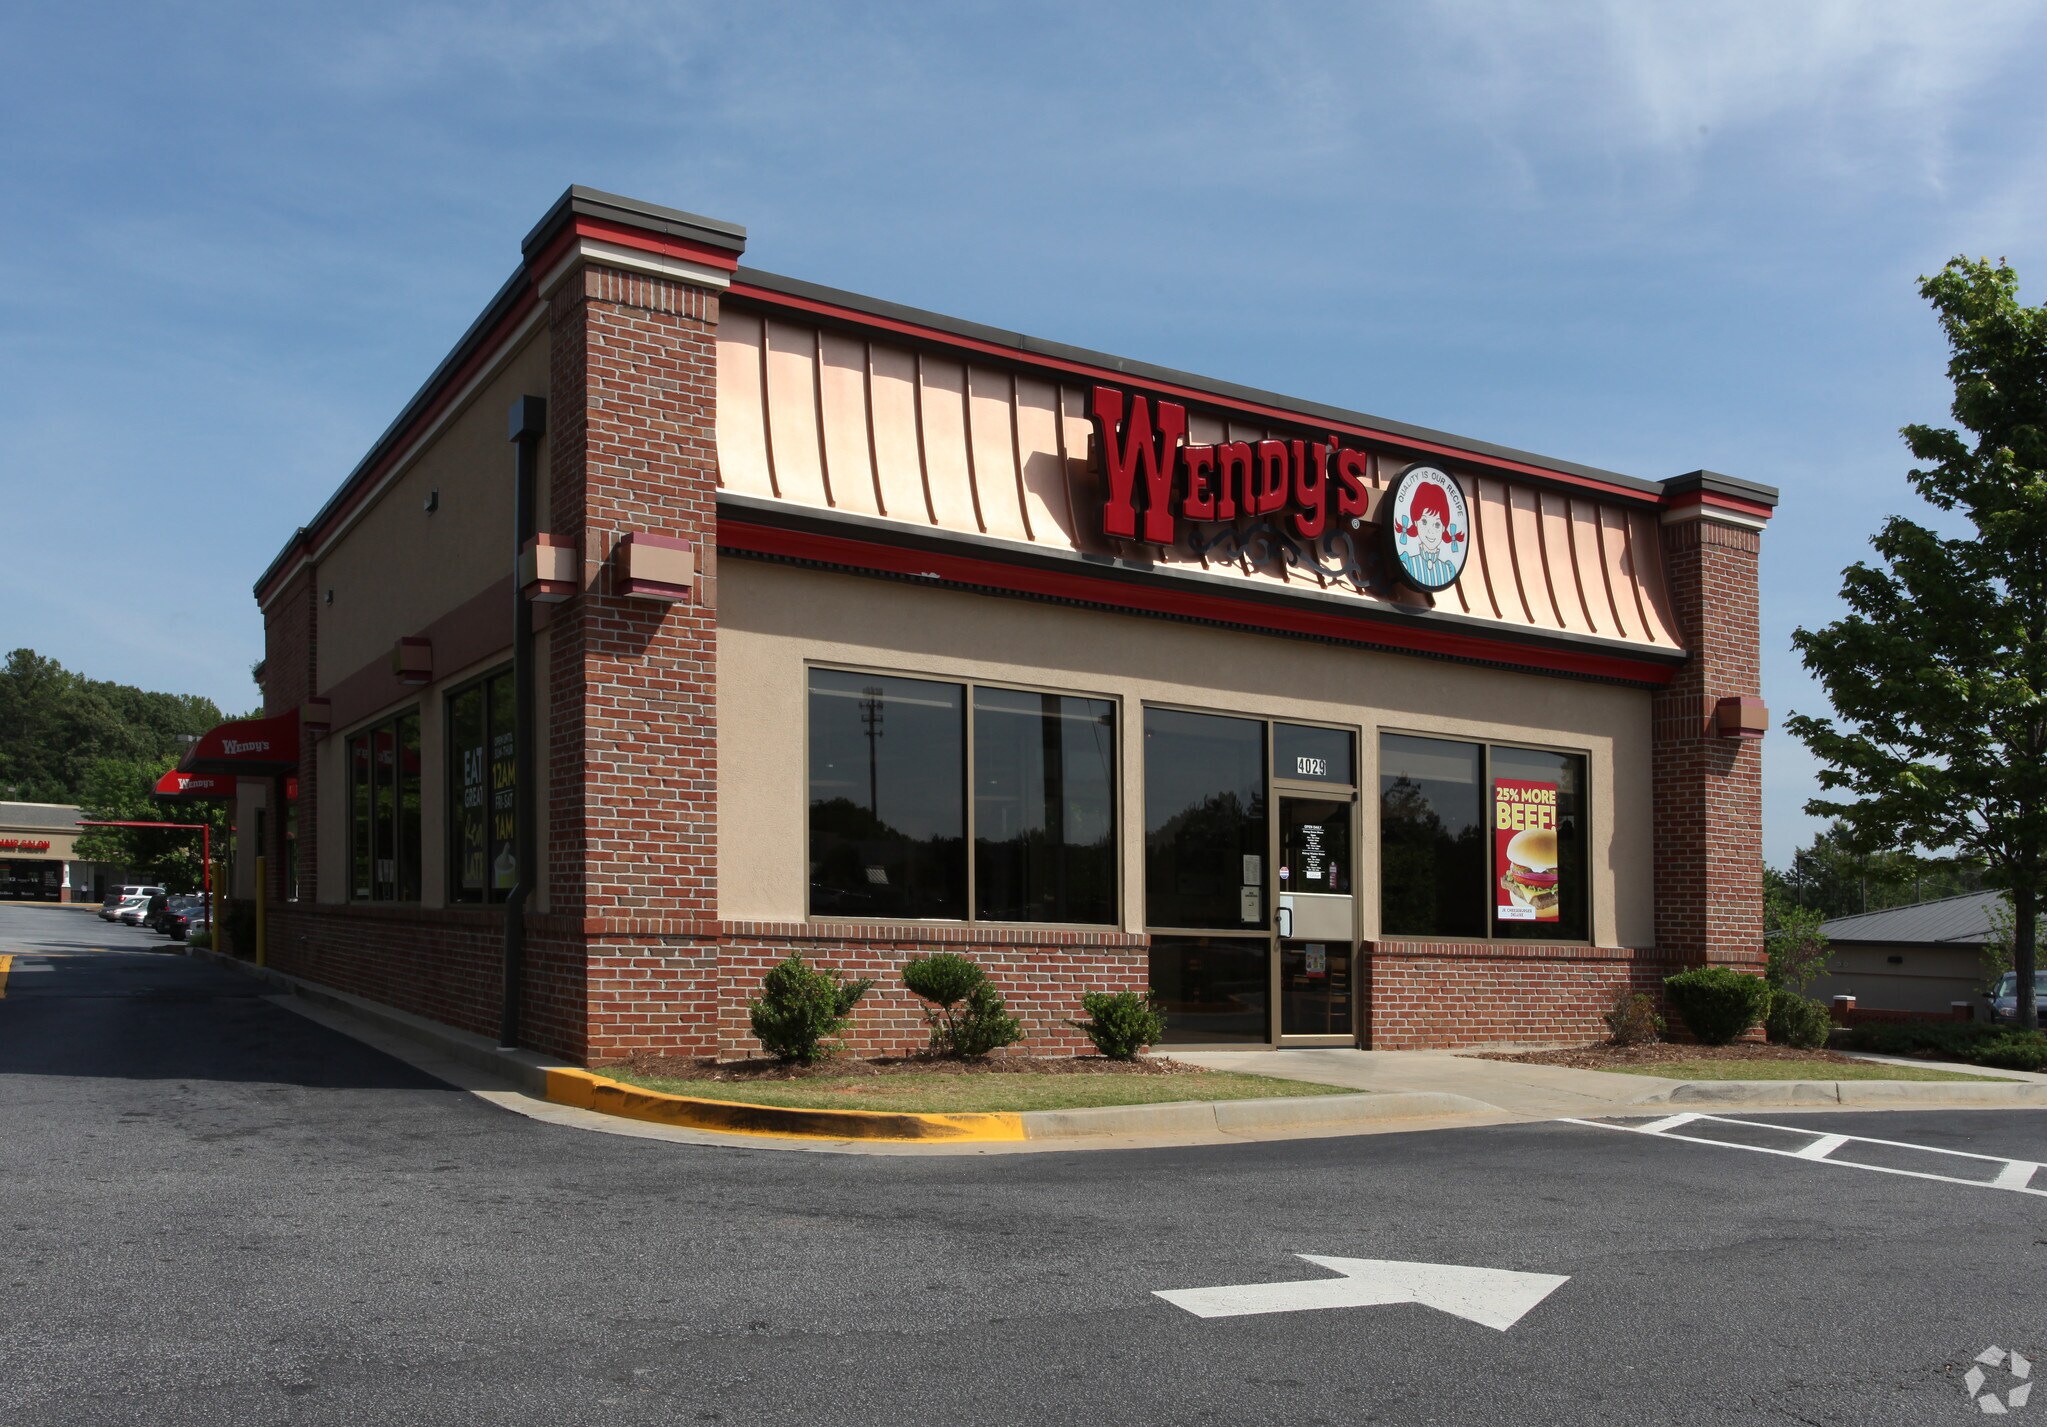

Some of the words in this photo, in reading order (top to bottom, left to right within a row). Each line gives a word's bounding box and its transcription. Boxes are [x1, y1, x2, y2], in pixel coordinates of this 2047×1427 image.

[1398, 473, 1419, 503] QUALITY
[1422, 471, 1429, 479] IS
[1431, 472, 1446, 486] OUR
[1446, 484, 1464, 517] RECIPE
[464, 747, 483, 786] EAT
[493, 760, 516, 789] 12AM
[1298, 758, 1326, 775] 4029
[1496, 787, 1519, 801] 25%
[1521, 788, 1556, 804] MORE
[495, 813, 514, 840] 1AM
[1497, 802, 1557, 832] BEEF!
